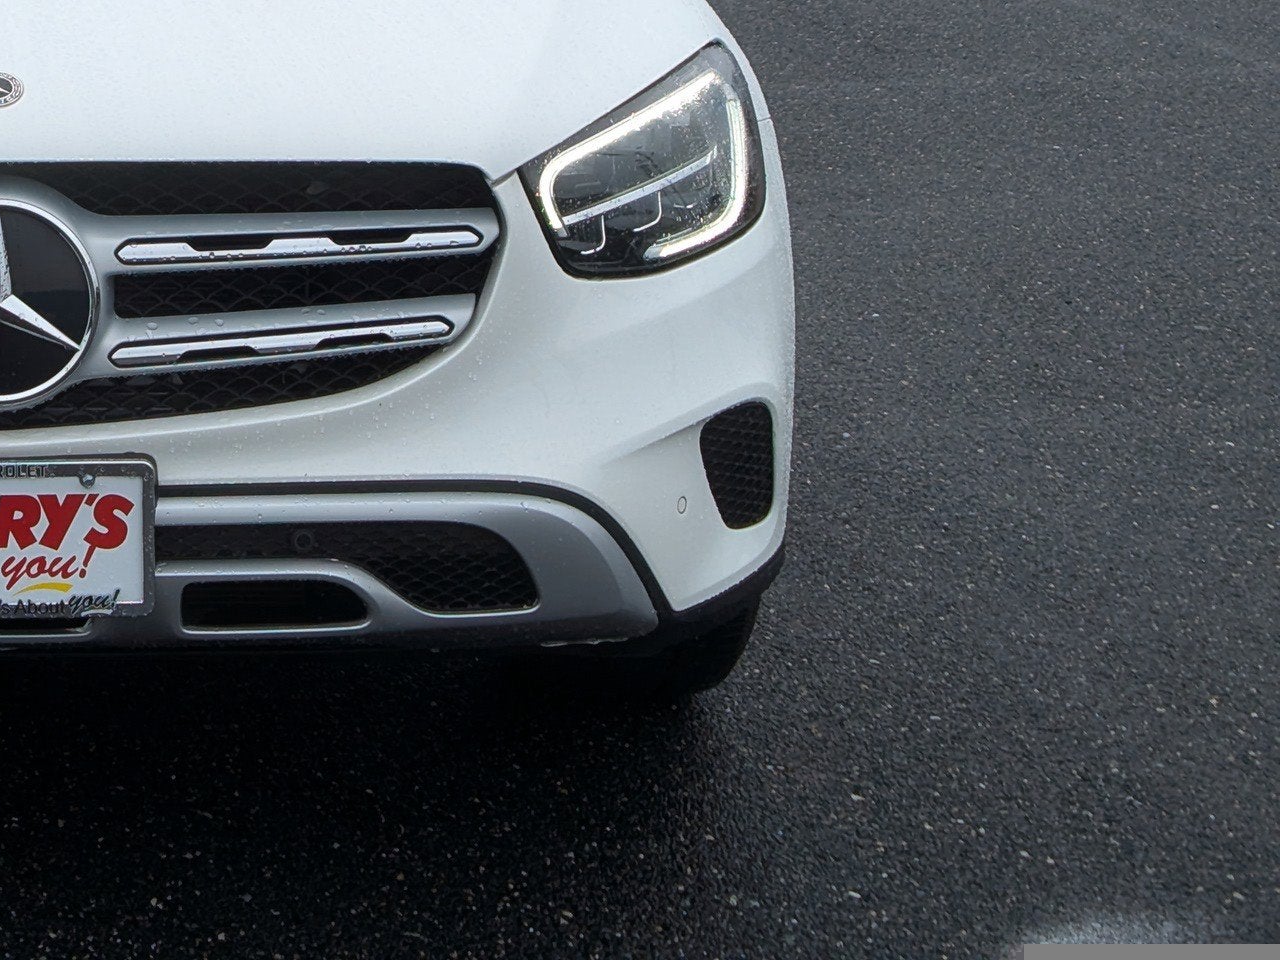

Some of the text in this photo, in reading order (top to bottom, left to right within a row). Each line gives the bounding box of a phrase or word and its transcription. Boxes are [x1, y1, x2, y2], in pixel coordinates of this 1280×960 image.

[0, 544, 97, 590] you!
[13, 598, 66, 616] About
[67, 588, 121, 615] you!
